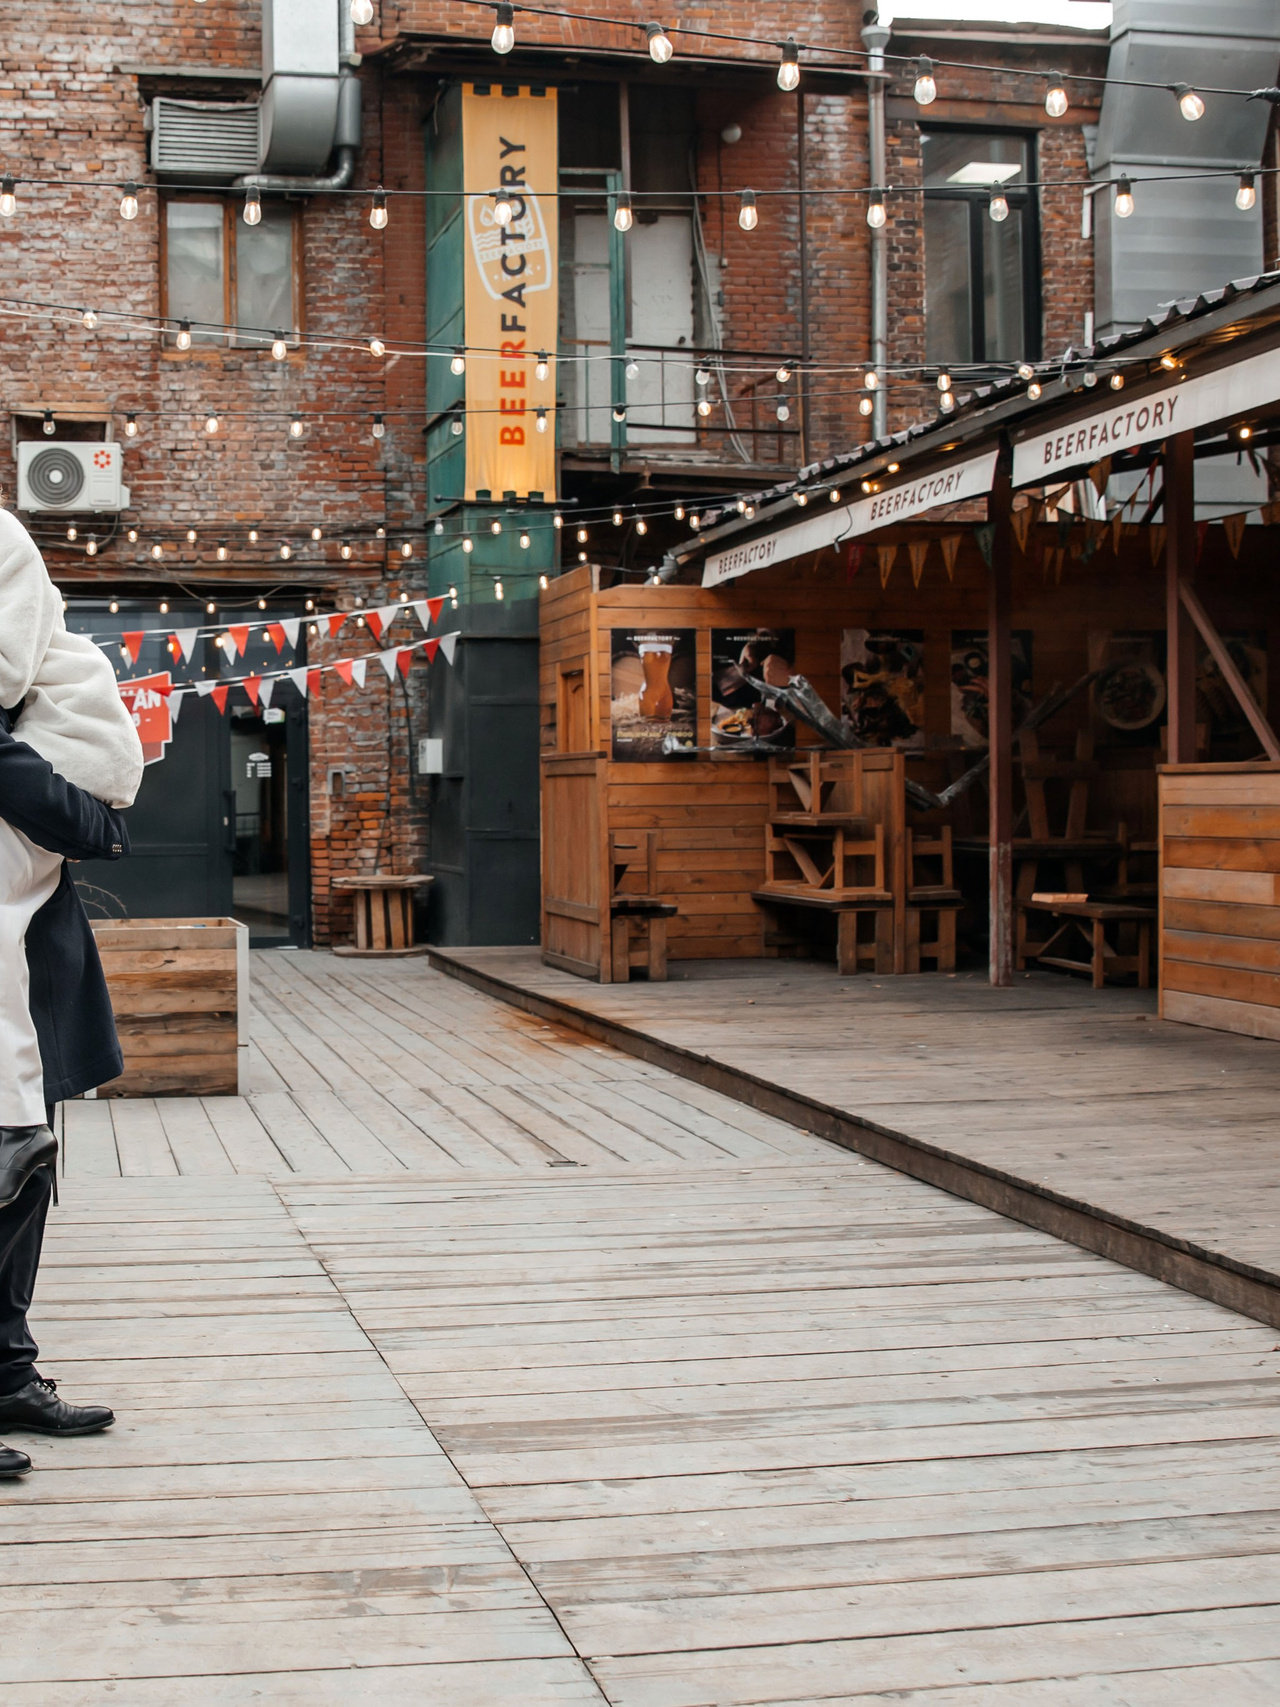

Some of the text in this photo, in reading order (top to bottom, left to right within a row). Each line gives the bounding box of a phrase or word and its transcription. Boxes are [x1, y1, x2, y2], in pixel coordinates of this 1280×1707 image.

[1043, 395, 1179, 465] BEERFACTORY
[870, 470, 965, 521] BEERFACTORY
[719, 539, 778, 575] BEERFACTORY
